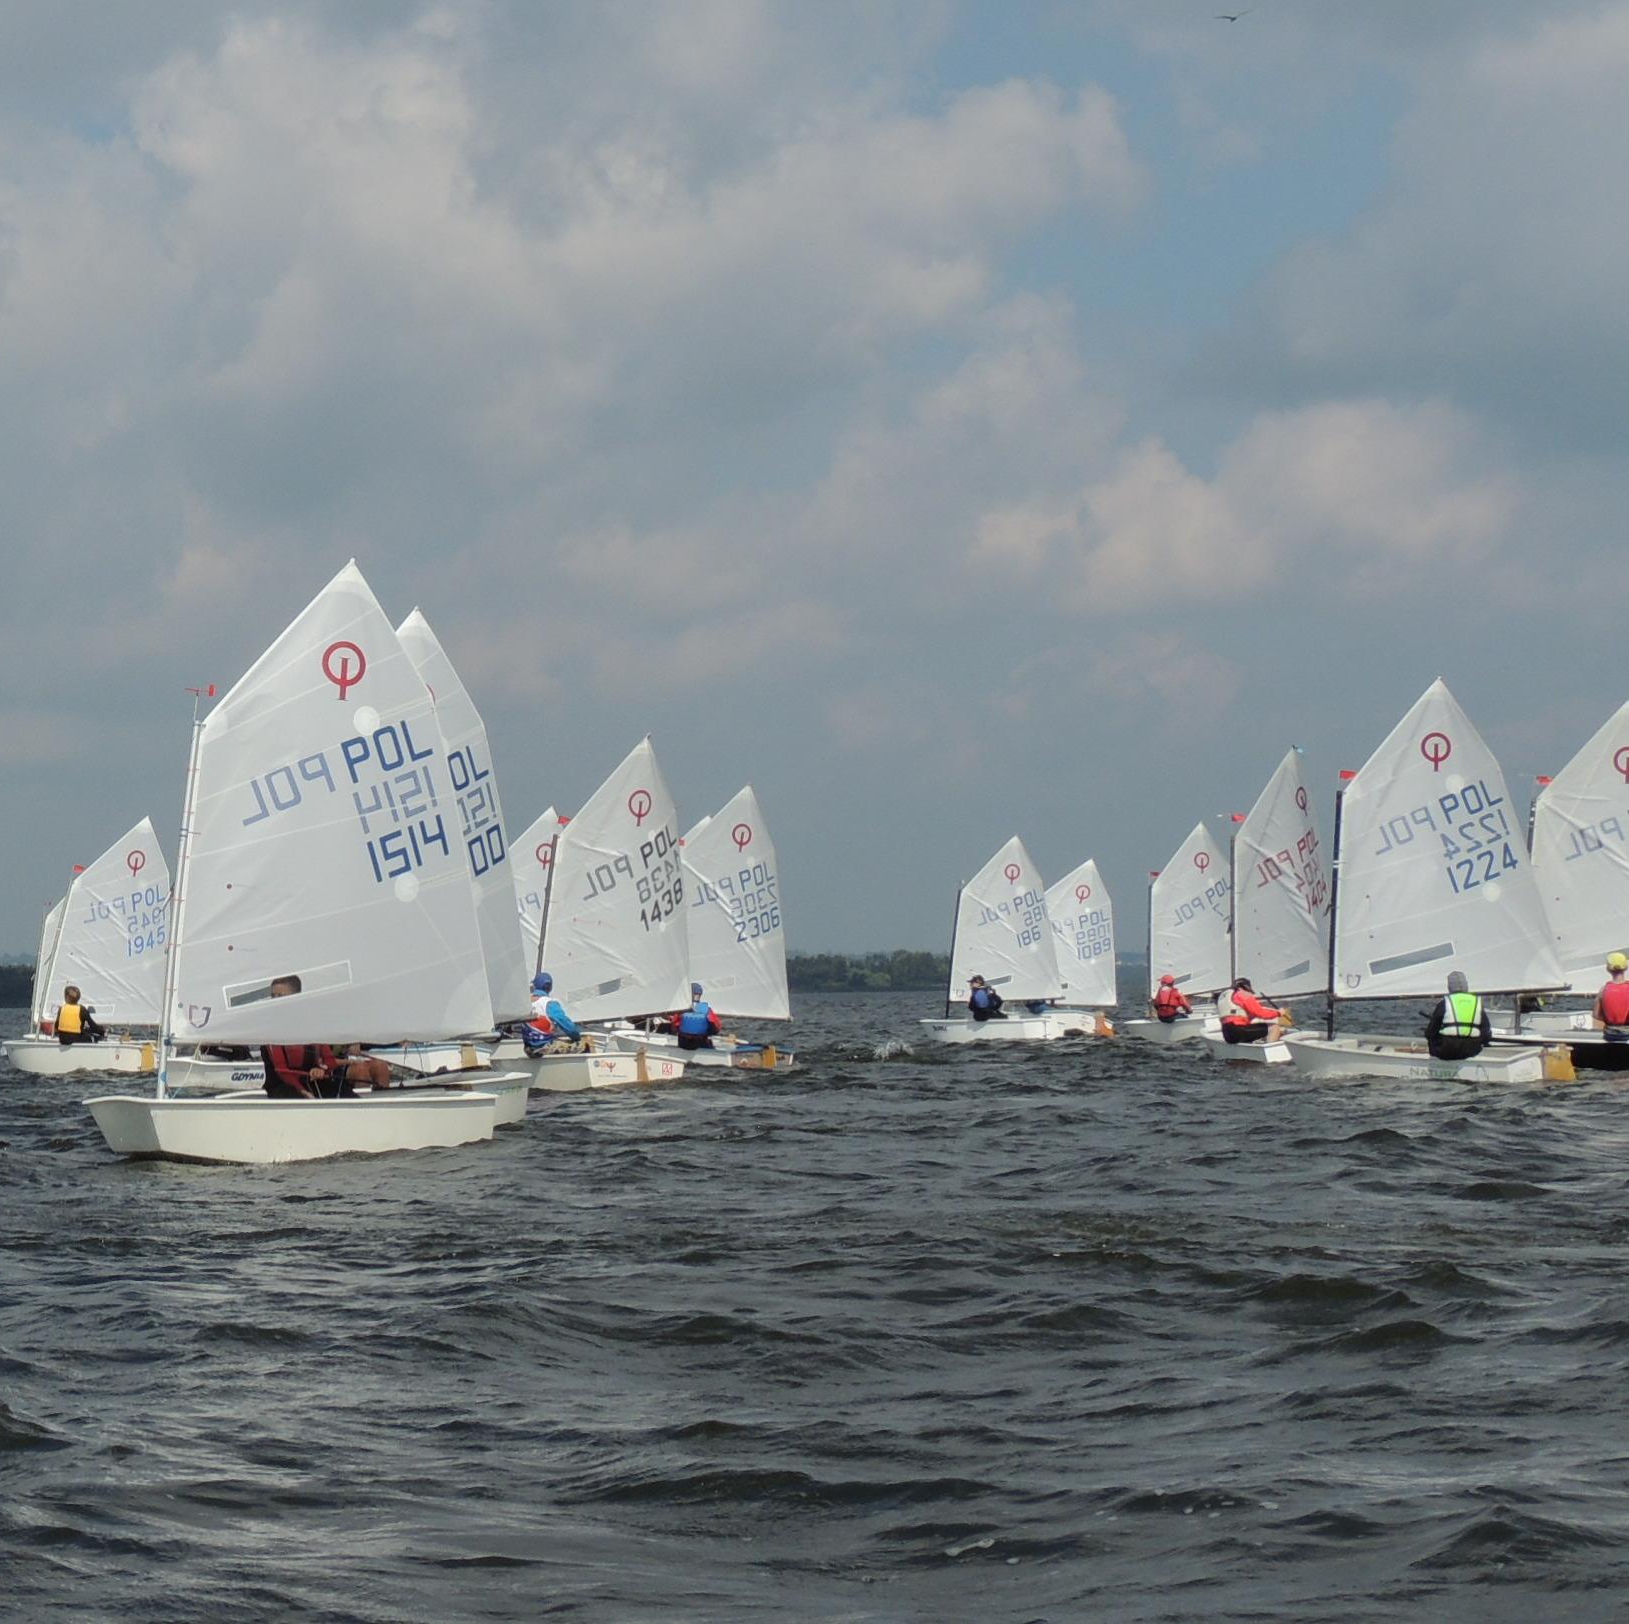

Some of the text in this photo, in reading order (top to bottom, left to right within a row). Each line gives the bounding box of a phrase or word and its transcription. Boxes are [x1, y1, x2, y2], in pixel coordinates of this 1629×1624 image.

[341, 720, 434, 784] POL
[447, 745, 490, 791] OL
[1439, 780, 1504, 825] POL
[367, 814, 450, 883] 1514
[467, 824, 506, 877] 00
[640, 825, 678, 869] POL
[739, 861, 775, 892] POL
[1446, 842, 1519, 894] 1224
[131, 885, 166, 912] POL
[640, 878, 683, 932] 1438
[1013, 889, 1044, 913] POL
[1204, 878, 1232, 904] POL
[734, 907, 780, 943] 2306
[1016, 925, 1042, 948] 186
[1079, 910, 1110, 929] POL
[127, 925, 166, 957] 1945
[1077, 937, 1111, 960] 1089
